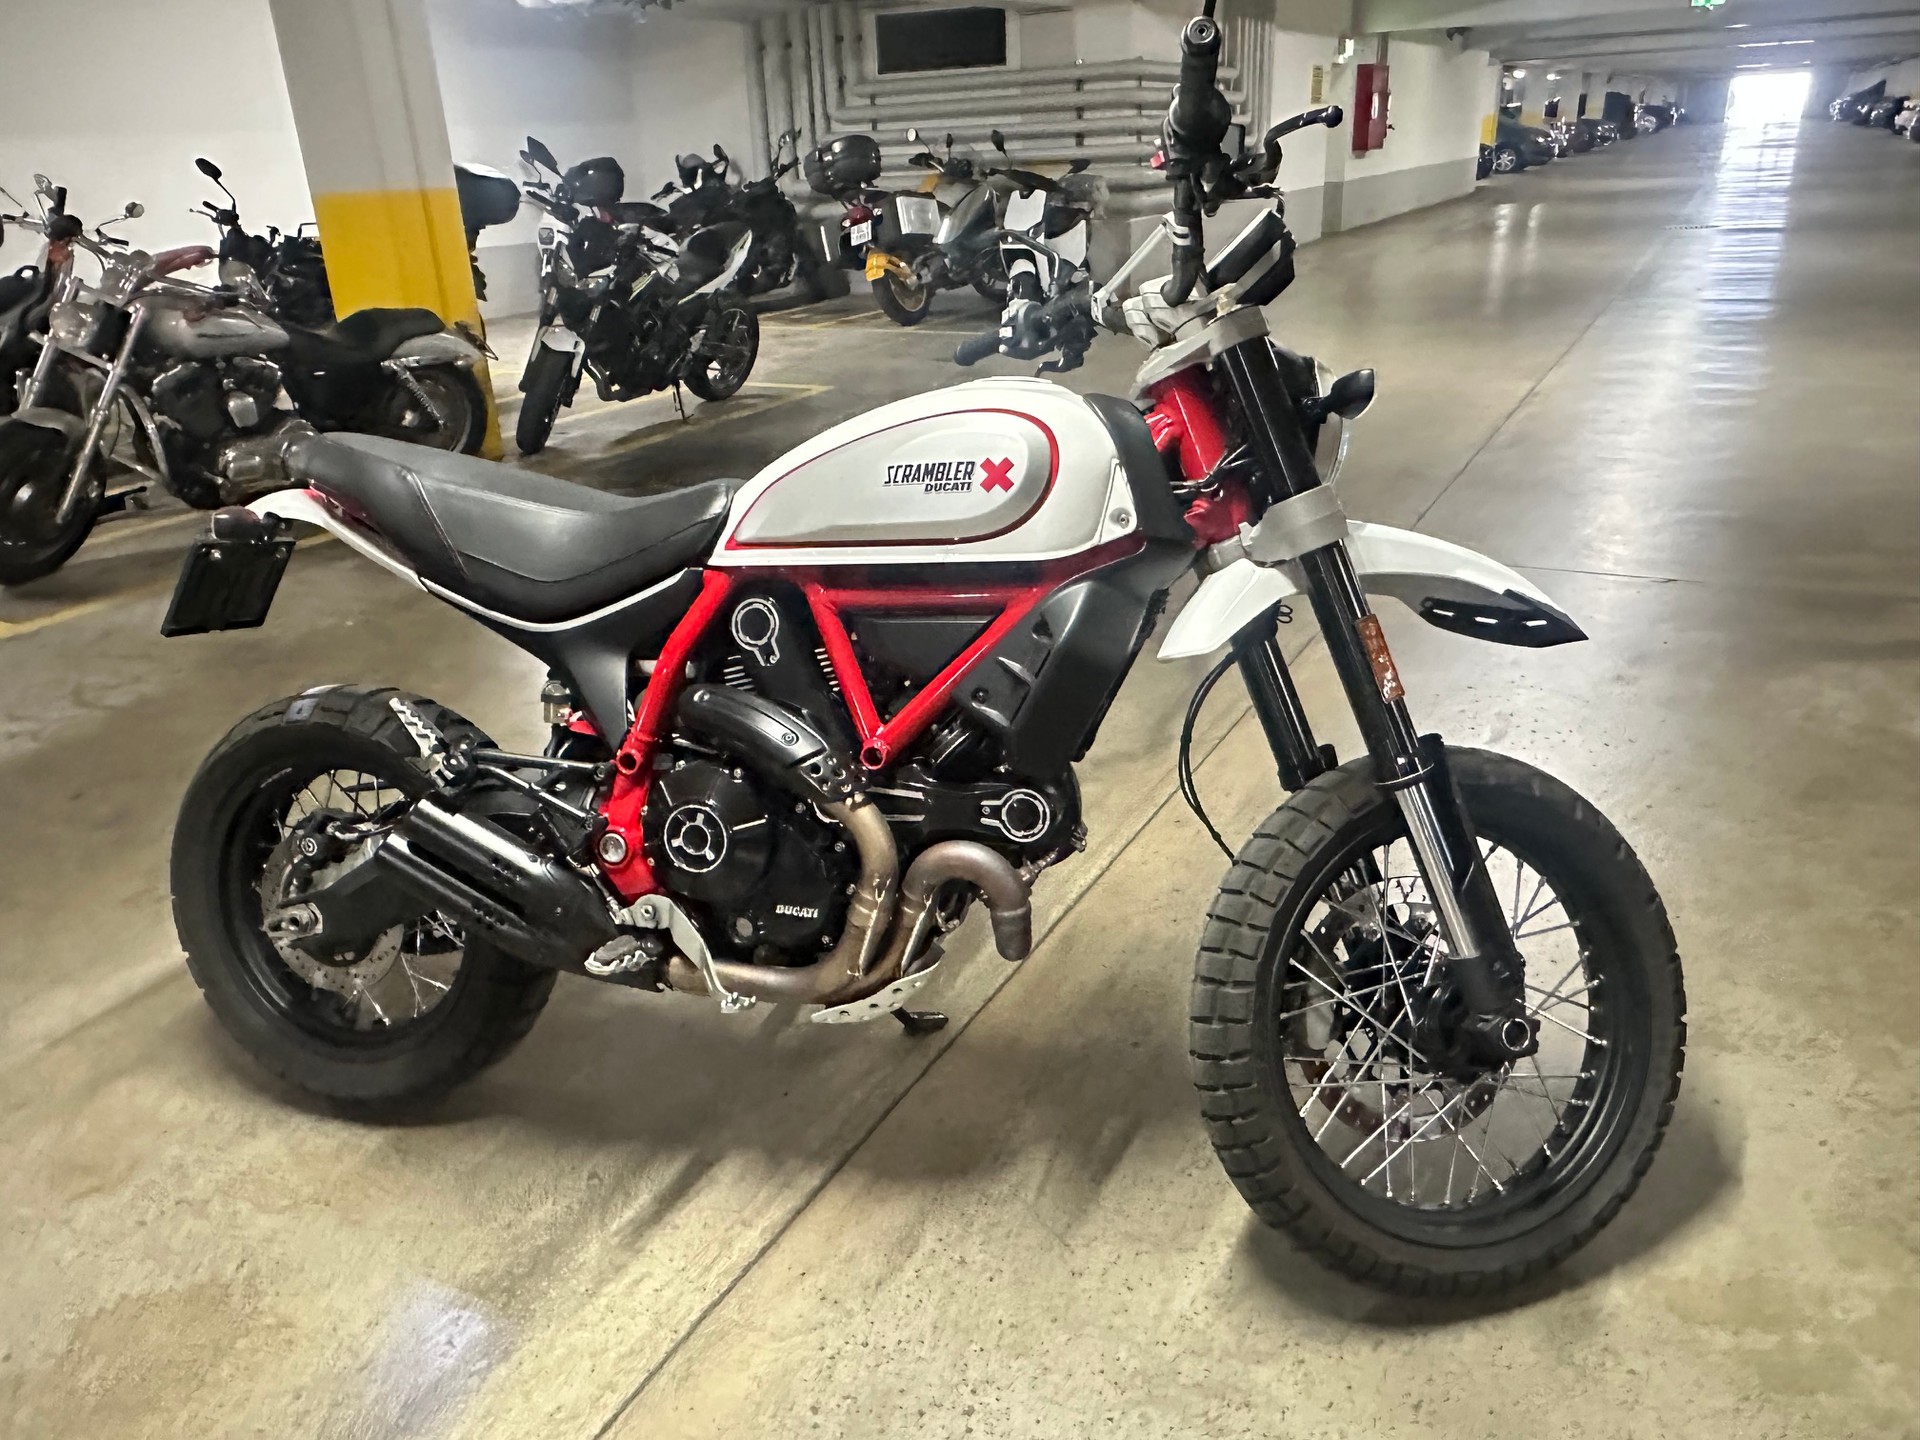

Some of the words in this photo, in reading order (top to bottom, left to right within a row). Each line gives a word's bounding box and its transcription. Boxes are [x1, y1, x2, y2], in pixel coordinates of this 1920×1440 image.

[884, 461, 976, 484] SCRAMBLER
[924, 481, 972, 492] DUCATI
[775, 904, 819, 918] DUCATI
